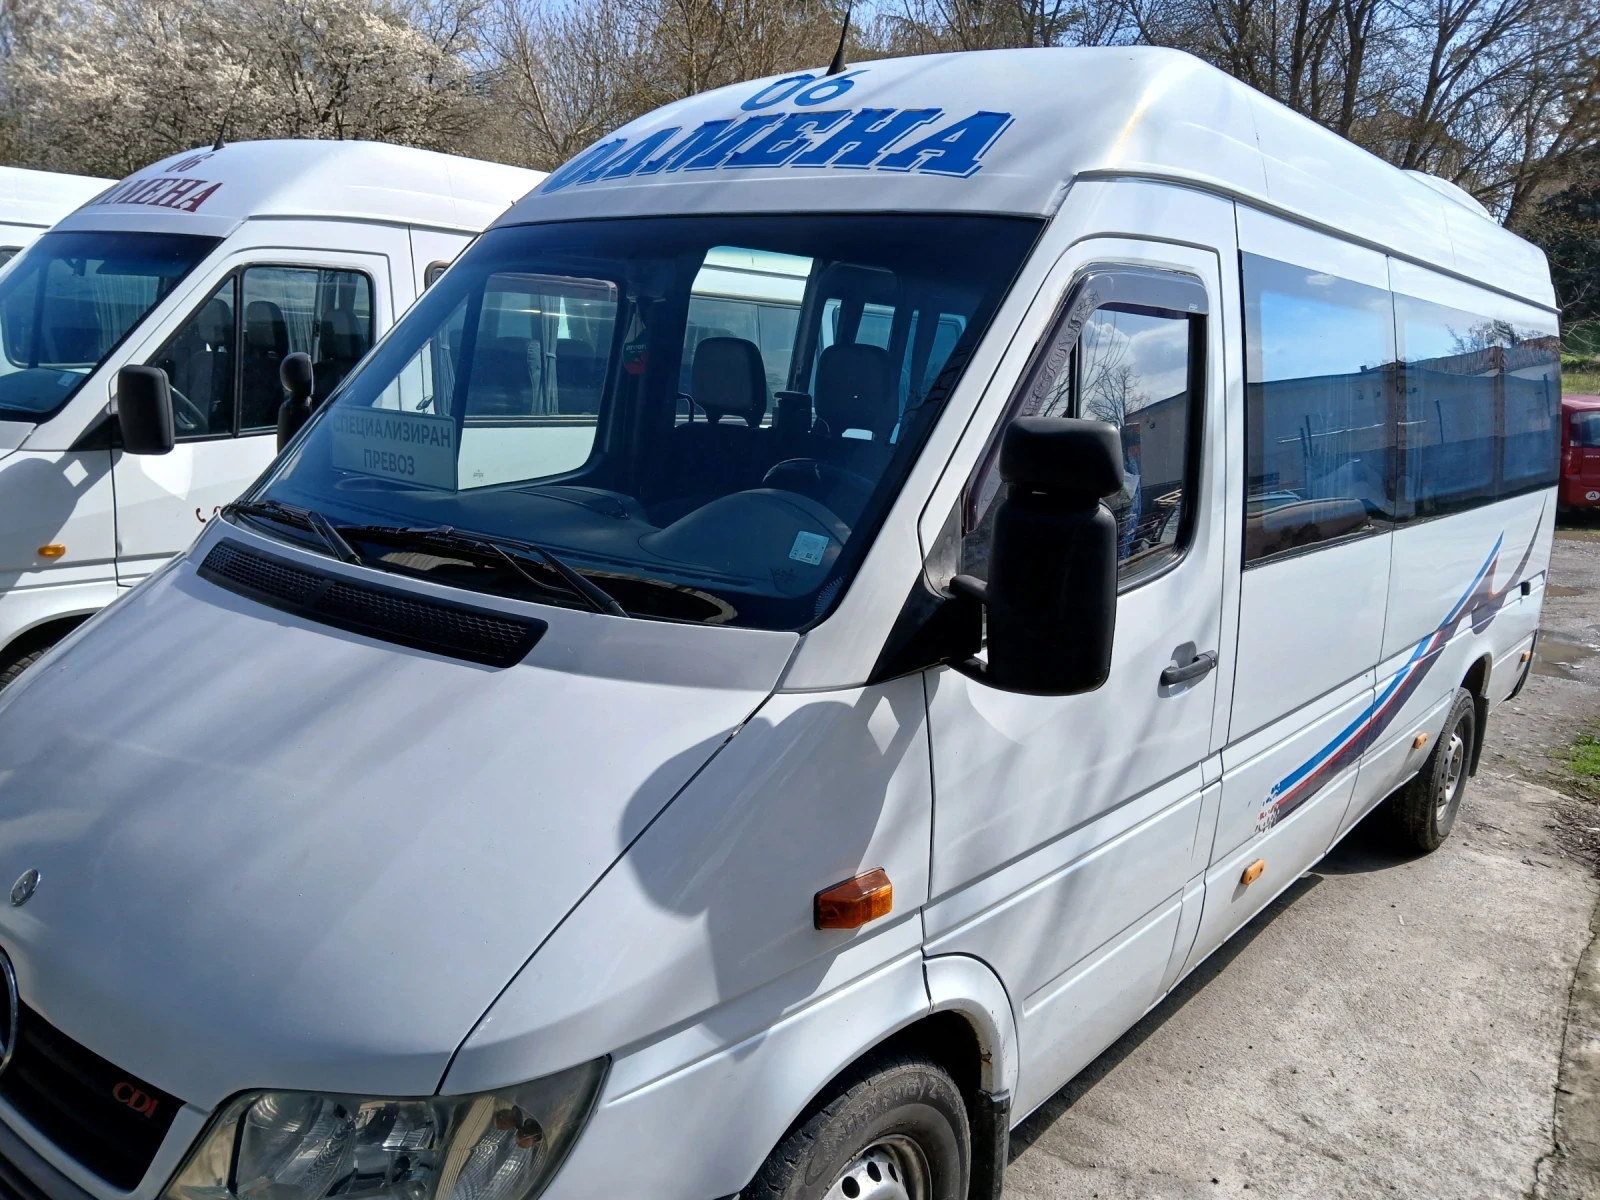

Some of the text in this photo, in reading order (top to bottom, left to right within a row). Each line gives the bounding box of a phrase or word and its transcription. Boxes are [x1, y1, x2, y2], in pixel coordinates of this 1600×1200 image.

[741, 70, 870, 110] 06
[333, 415, 451, 448] СПЕЦИАЛИЗИРАН
[364, 449, 415, 476] ПРЕВОЗ
[112, 1081, 159, 1118] CDI
